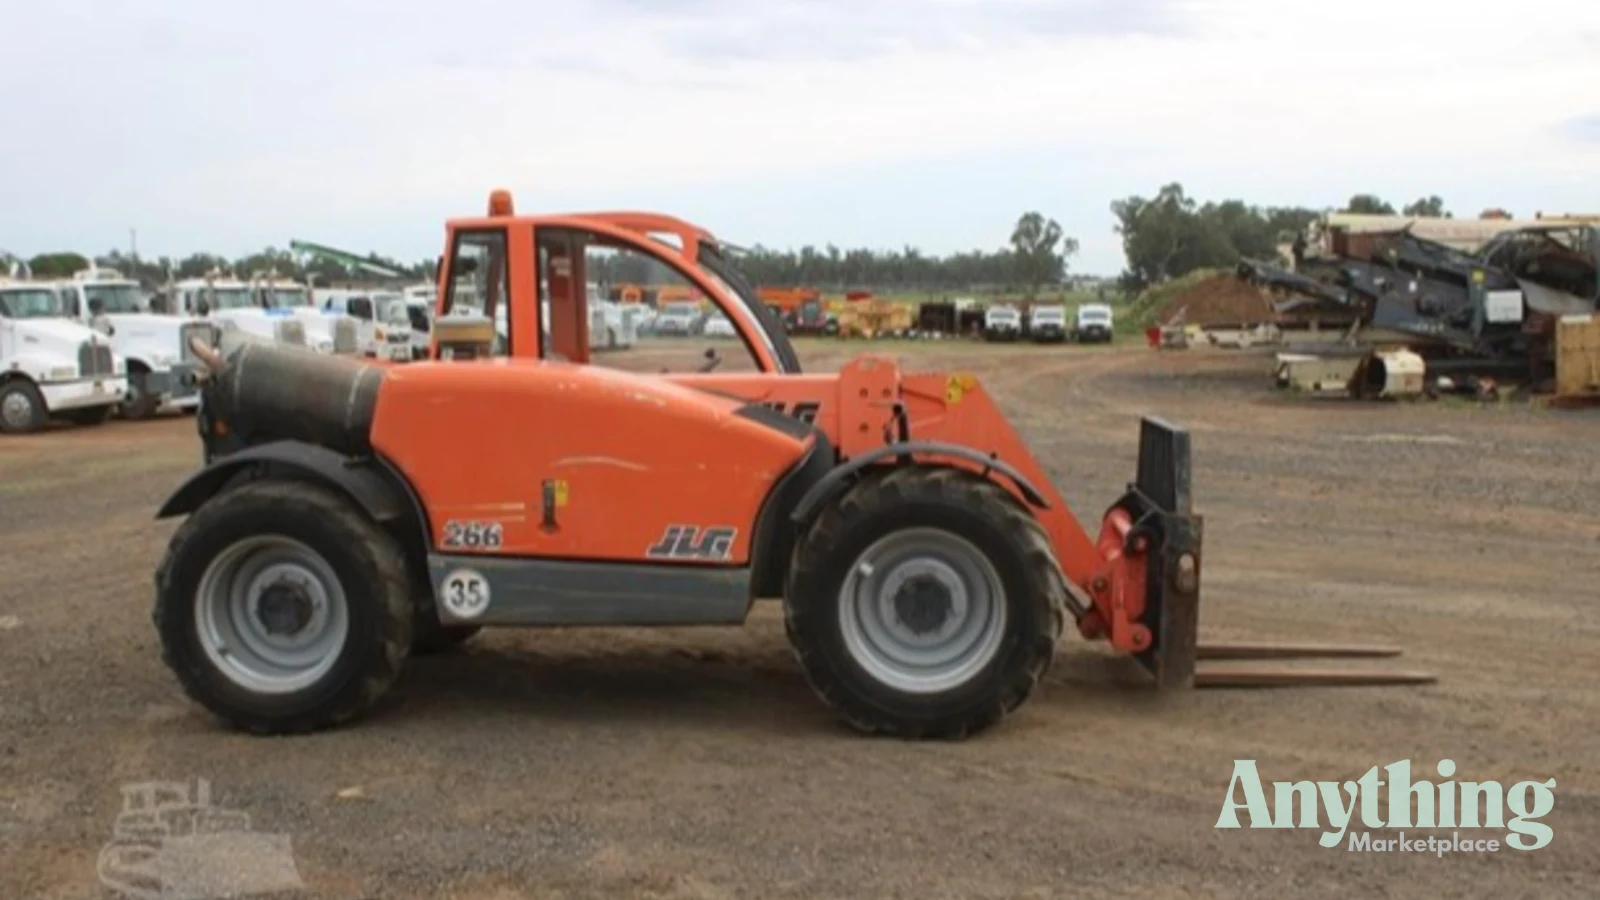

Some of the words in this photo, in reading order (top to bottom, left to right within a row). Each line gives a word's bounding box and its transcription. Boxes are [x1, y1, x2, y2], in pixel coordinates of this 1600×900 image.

[442, 520, 502, 548] 266
[645, 525, 737, 559] JLG
[450, 579, 482, 606] 35
